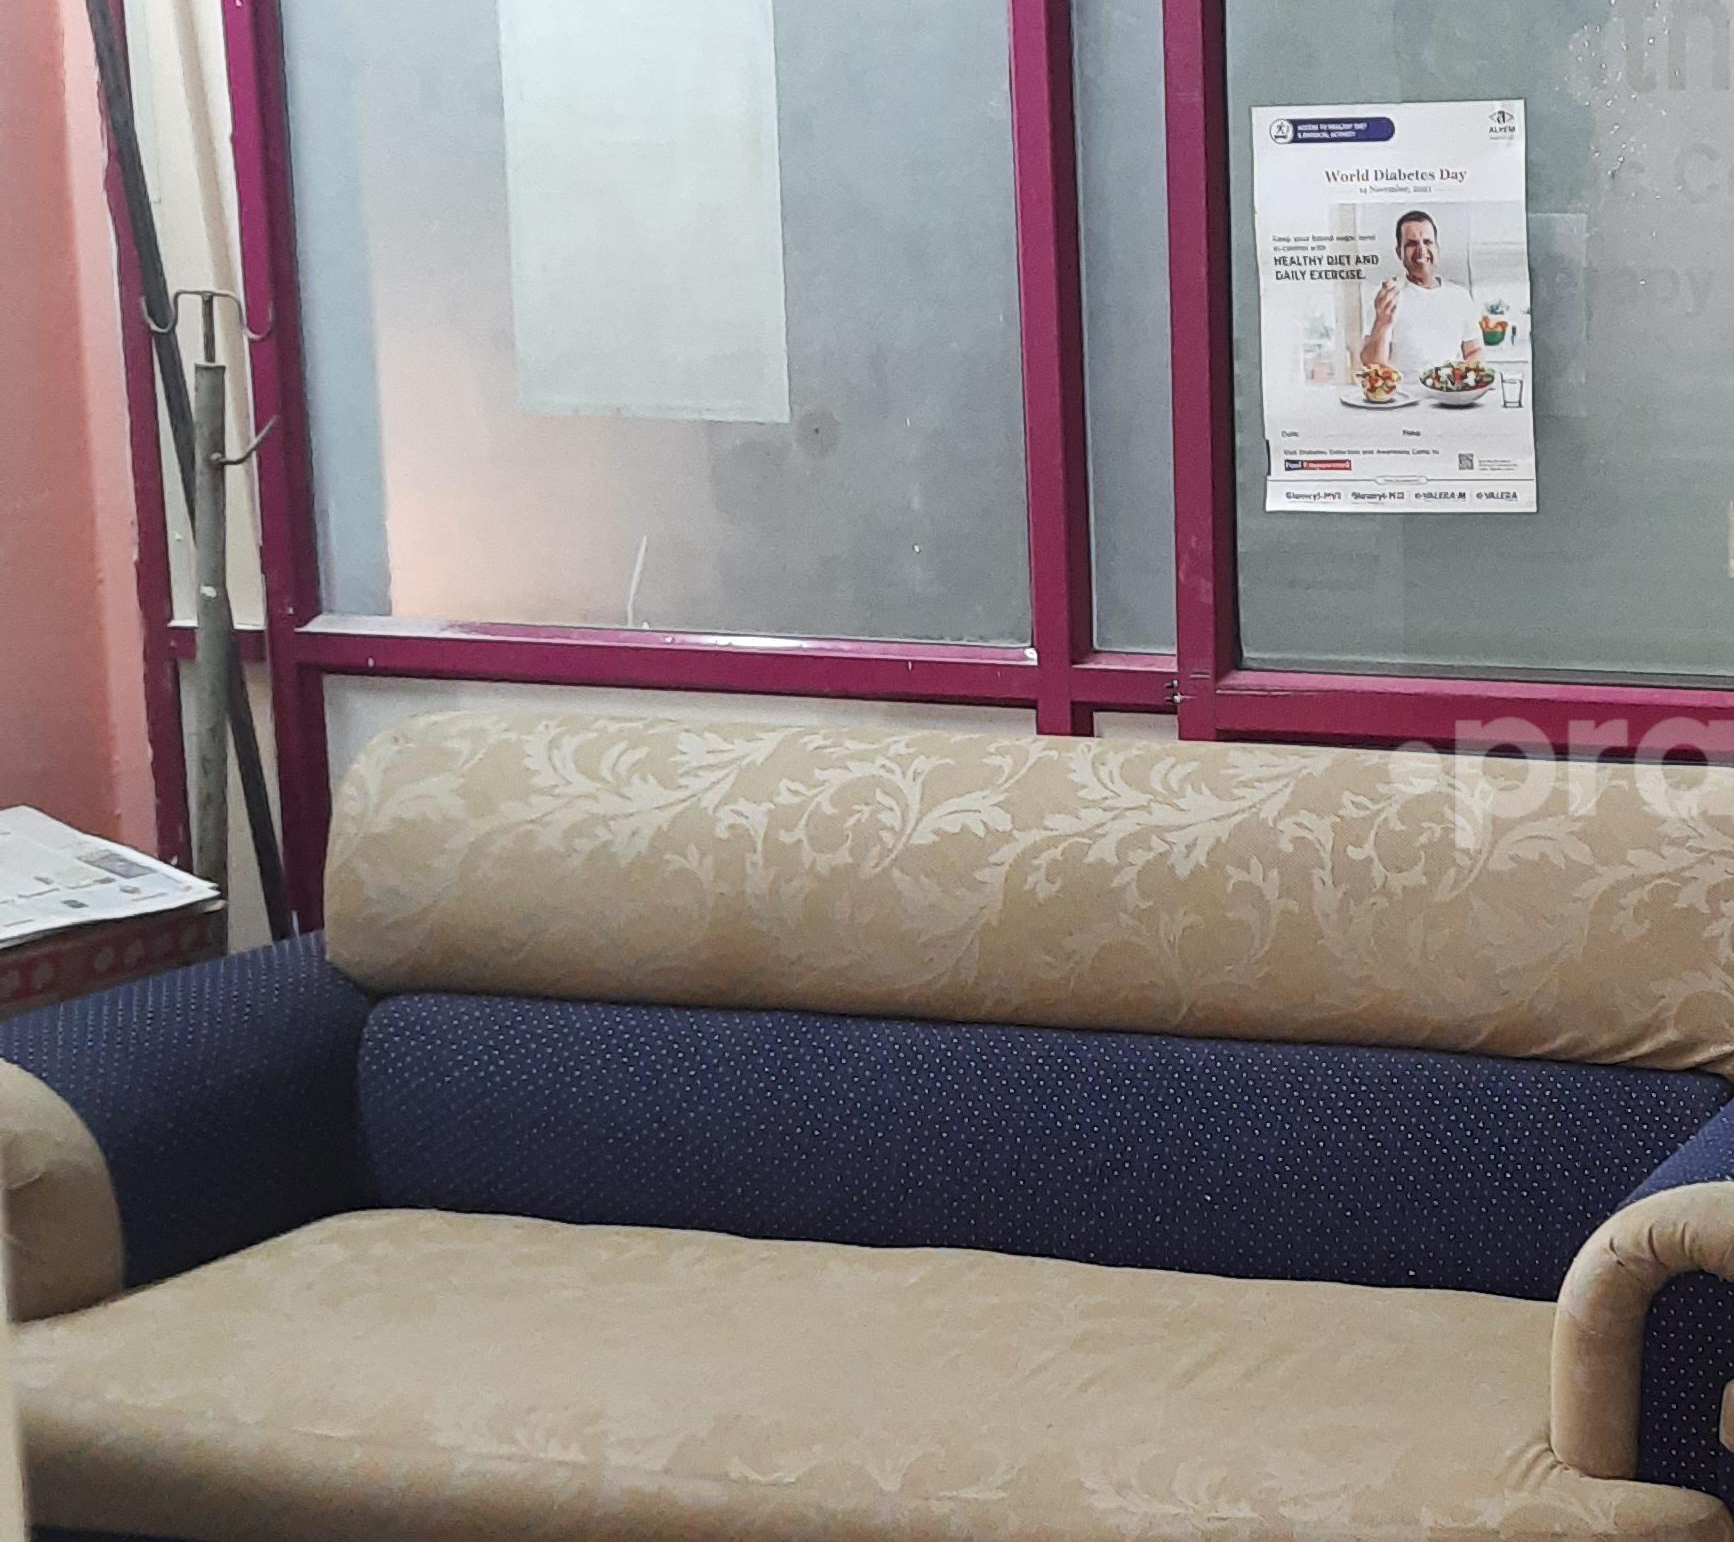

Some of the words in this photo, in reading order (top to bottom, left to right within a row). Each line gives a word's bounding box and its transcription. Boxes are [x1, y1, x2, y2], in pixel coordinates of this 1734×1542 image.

[1324, 168, 1369, 183] World
[1374, 168, 1436, 182] Diabetes
[1439, 168, 1467, 183] Day
[1273, 255, 1323, 267] HEALTHY
[1327, 255, 1351, 266] DIET
[1355, 254, 1380, 266] AND
[1275, 269, 1307, 281] DAILY
